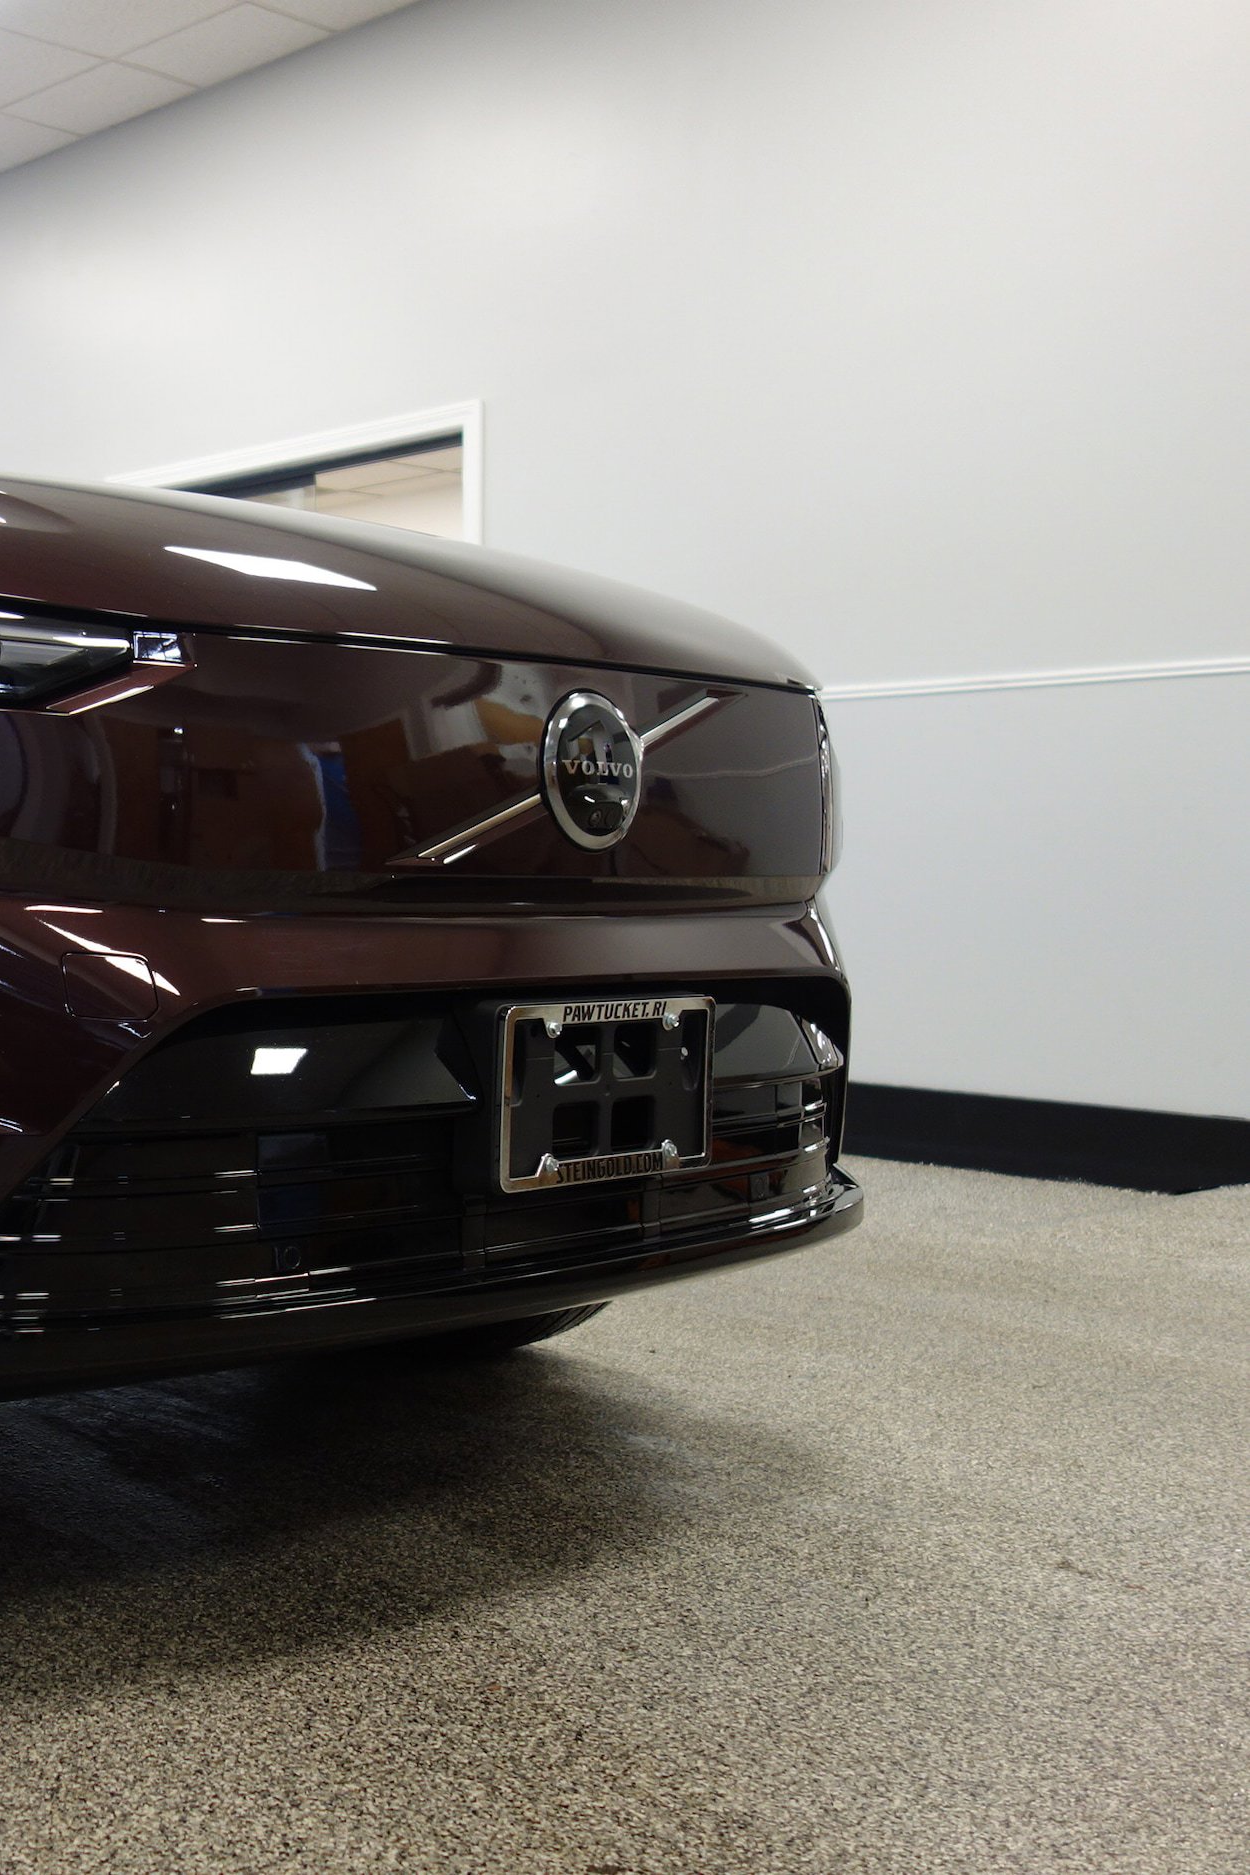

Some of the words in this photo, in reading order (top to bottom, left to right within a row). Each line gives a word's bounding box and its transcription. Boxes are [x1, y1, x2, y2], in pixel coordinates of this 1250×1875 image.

[561, 759, 634, 779] VOLVO
[562, 1002, 650, 1023] PAWTUCKET,
[652, 1000, 668, 1017] RI
[556, 1152, 664, 1184] STEINGOLD.COM
